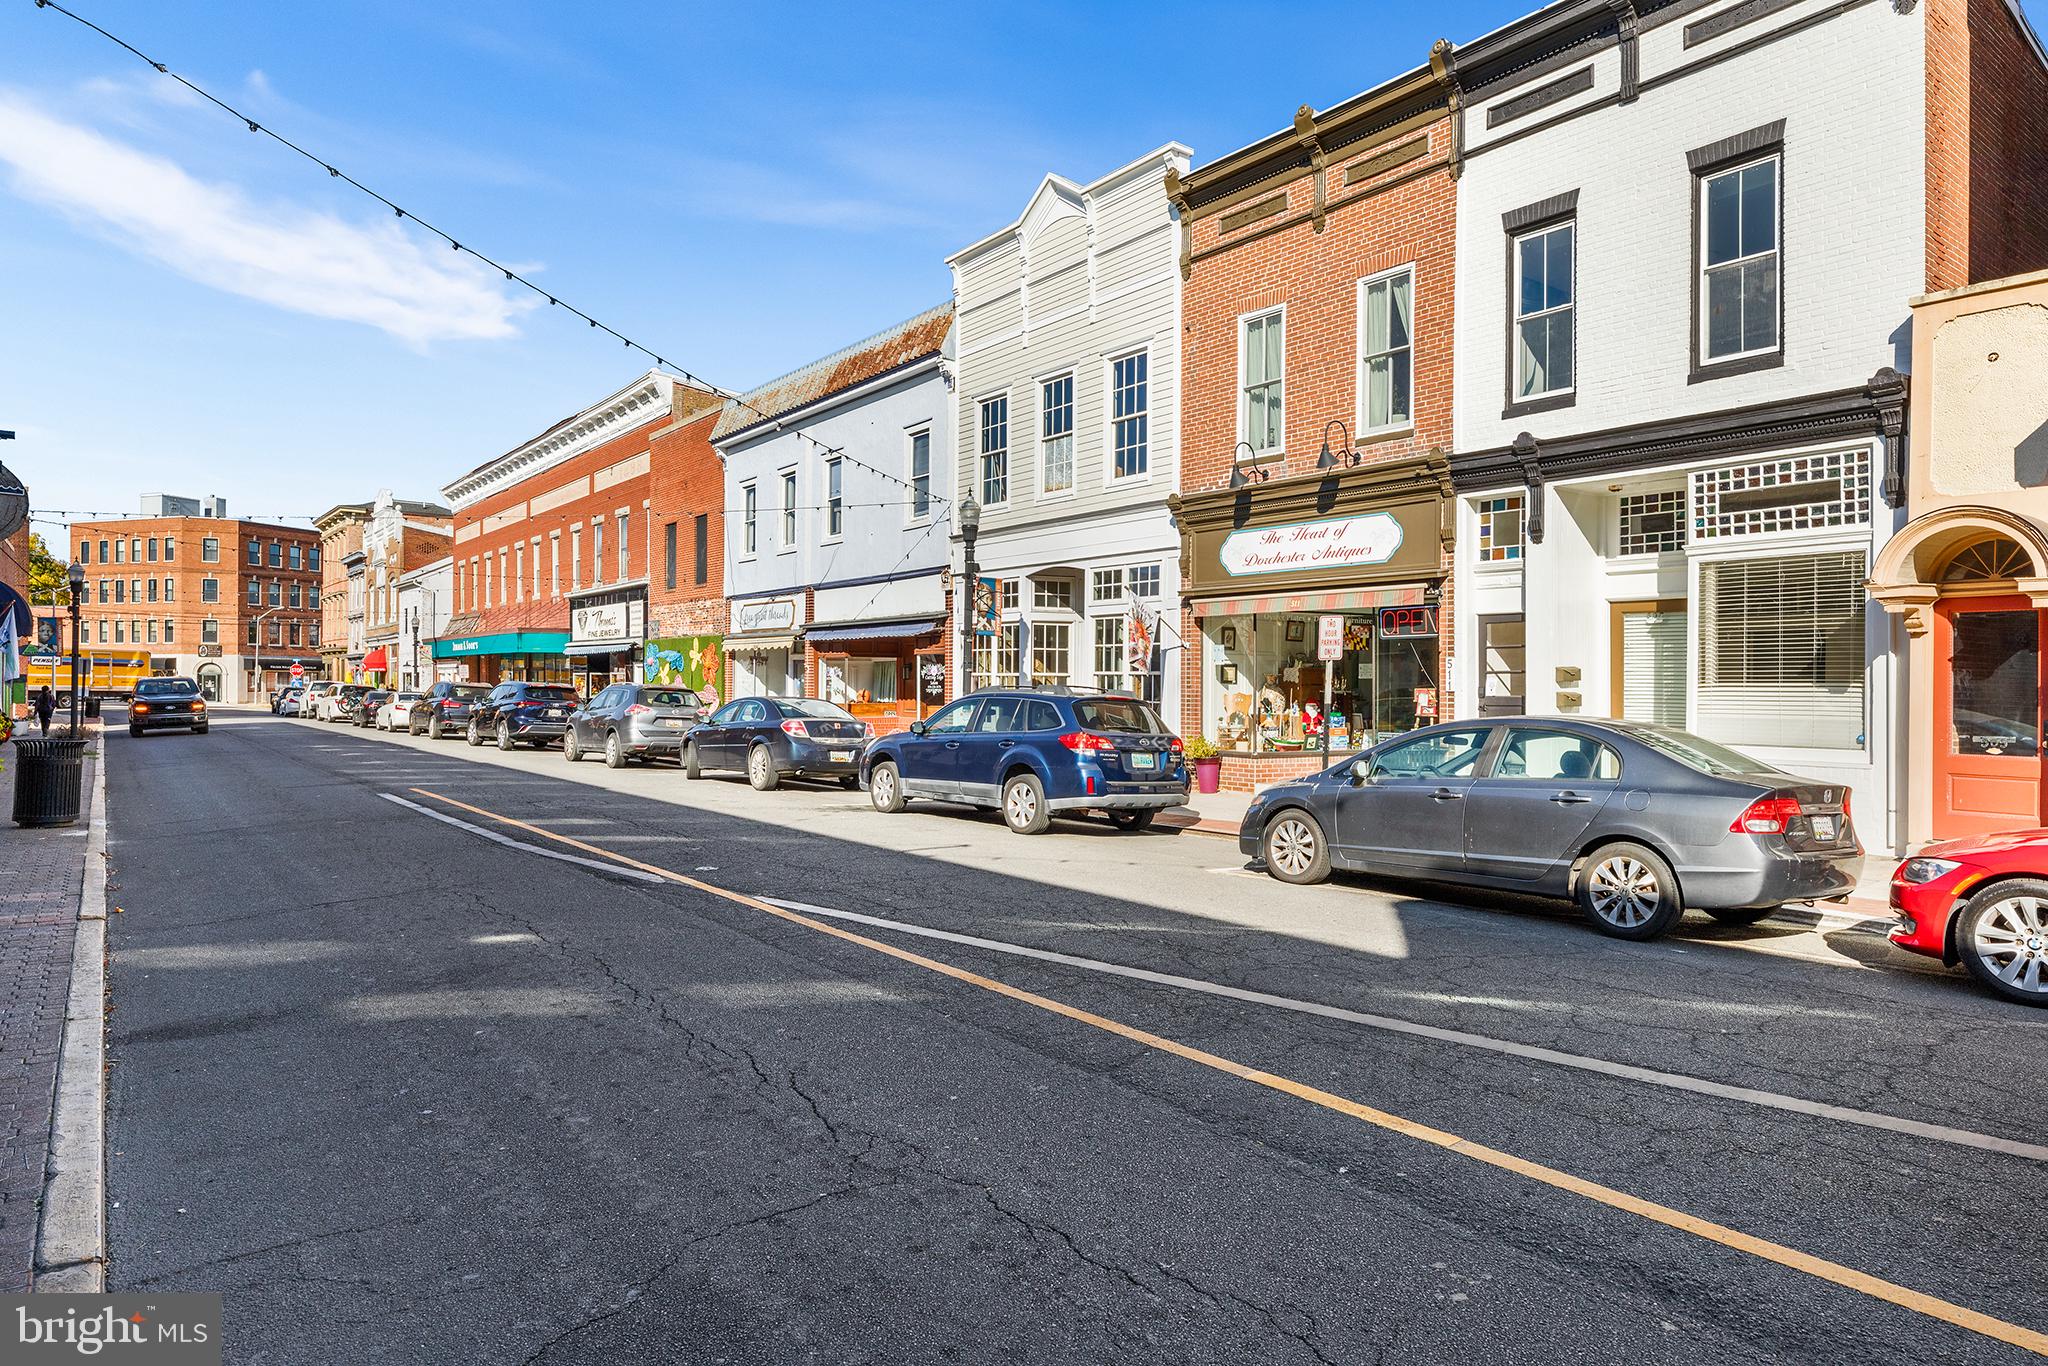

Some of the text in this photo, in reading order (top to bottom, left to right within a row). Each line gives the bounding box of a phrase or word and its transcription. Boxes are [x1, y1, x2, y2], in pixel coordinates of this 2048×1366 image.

[1259, 520, 1353, 545] The Heart of
[1242, 544, 1373, 567] Dorchester Antiques
[1291, 600, 1300, 608] 511
[1326, 620, 1336, 628] TWO
[1382, 607, 1439, 635] OPEN
[598, 629, 621, 638] JEWELRY
